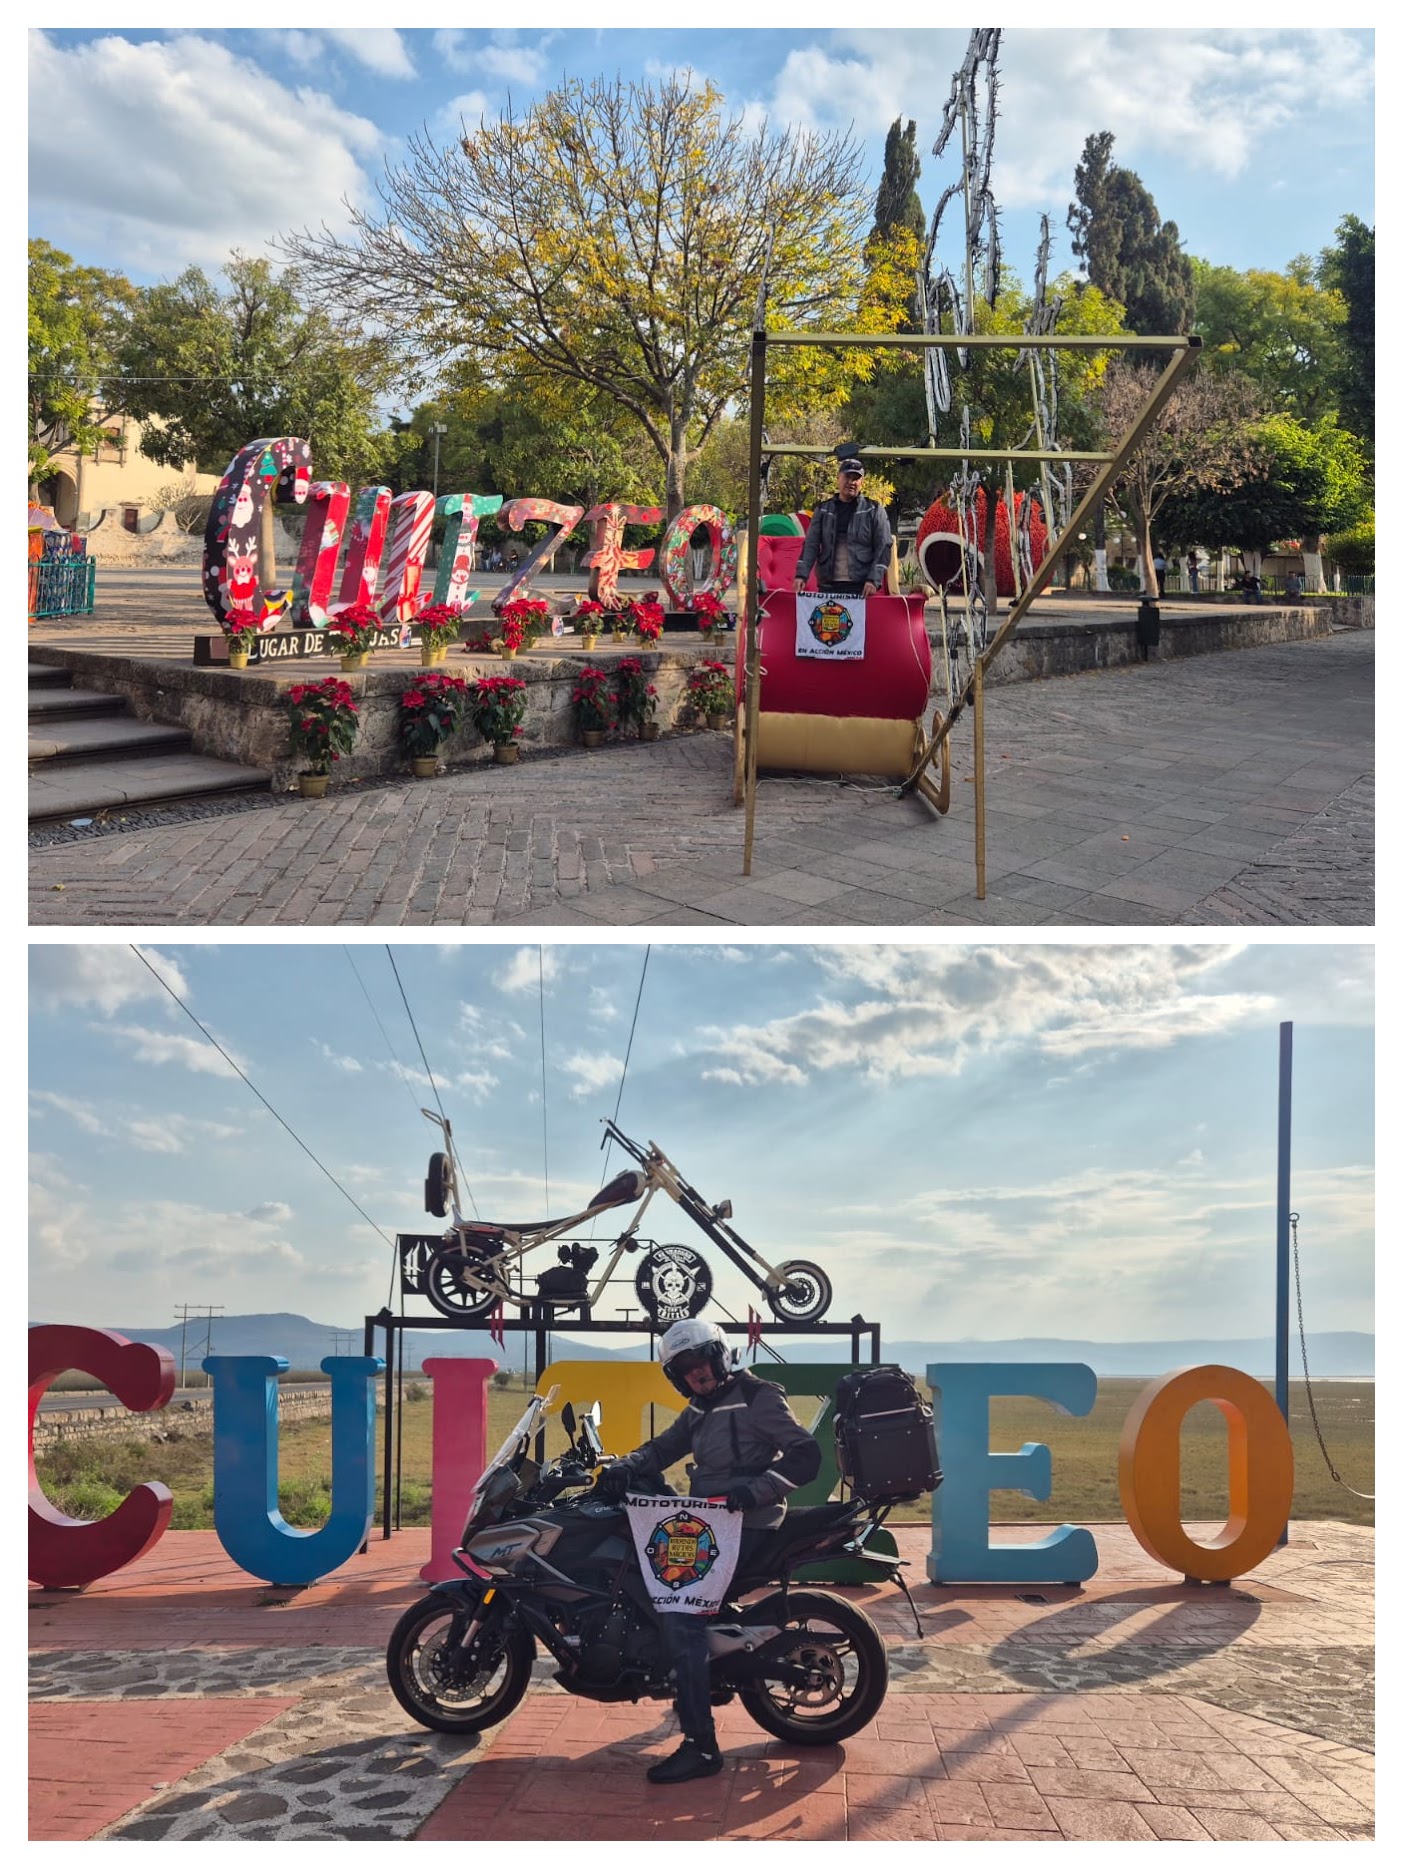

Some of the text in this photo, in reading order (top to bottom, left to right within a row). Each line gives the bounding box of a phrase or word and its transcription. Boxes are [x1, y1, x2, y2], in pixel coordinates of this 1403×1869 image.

[203, 436, 738, 634] CUITZEO
[248, 636, 299, 660] LUGAR
[304, 633, 324, 653] DE
[837, 648, 862, 656] MÉXICO
[679, 1513, 688, 1521] N
